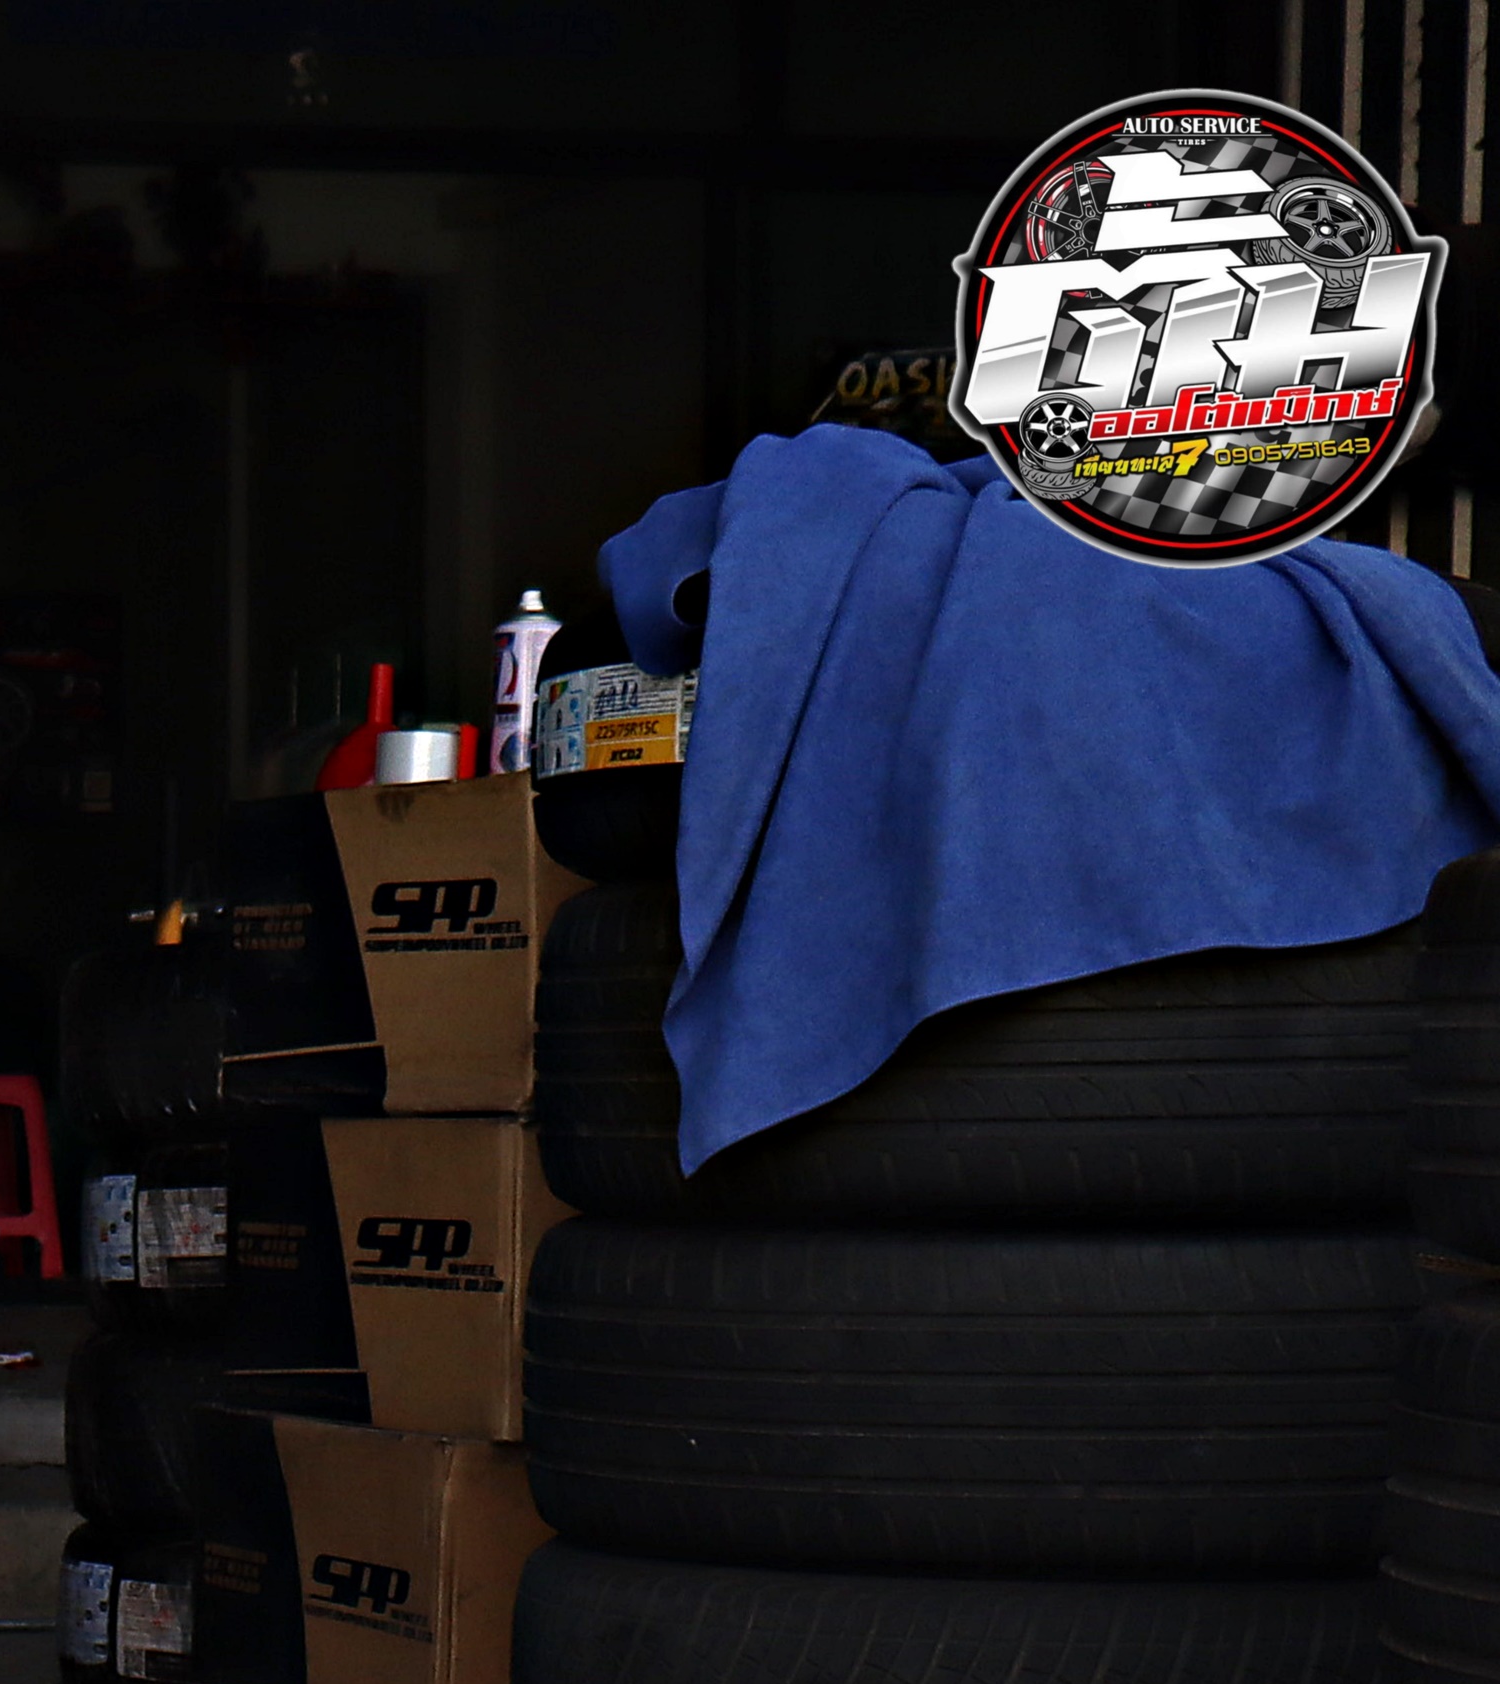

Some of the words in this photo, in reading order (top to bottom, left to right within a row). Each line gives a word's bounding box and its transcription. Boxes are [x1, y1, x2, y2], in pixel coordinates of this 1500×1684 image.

[836, 355, 956, 401] OASI
[367, 878, 498, 934] SPP
[352, 1217, 472, 1271] SPP
[310, 1553, 411, 1614] SPP
